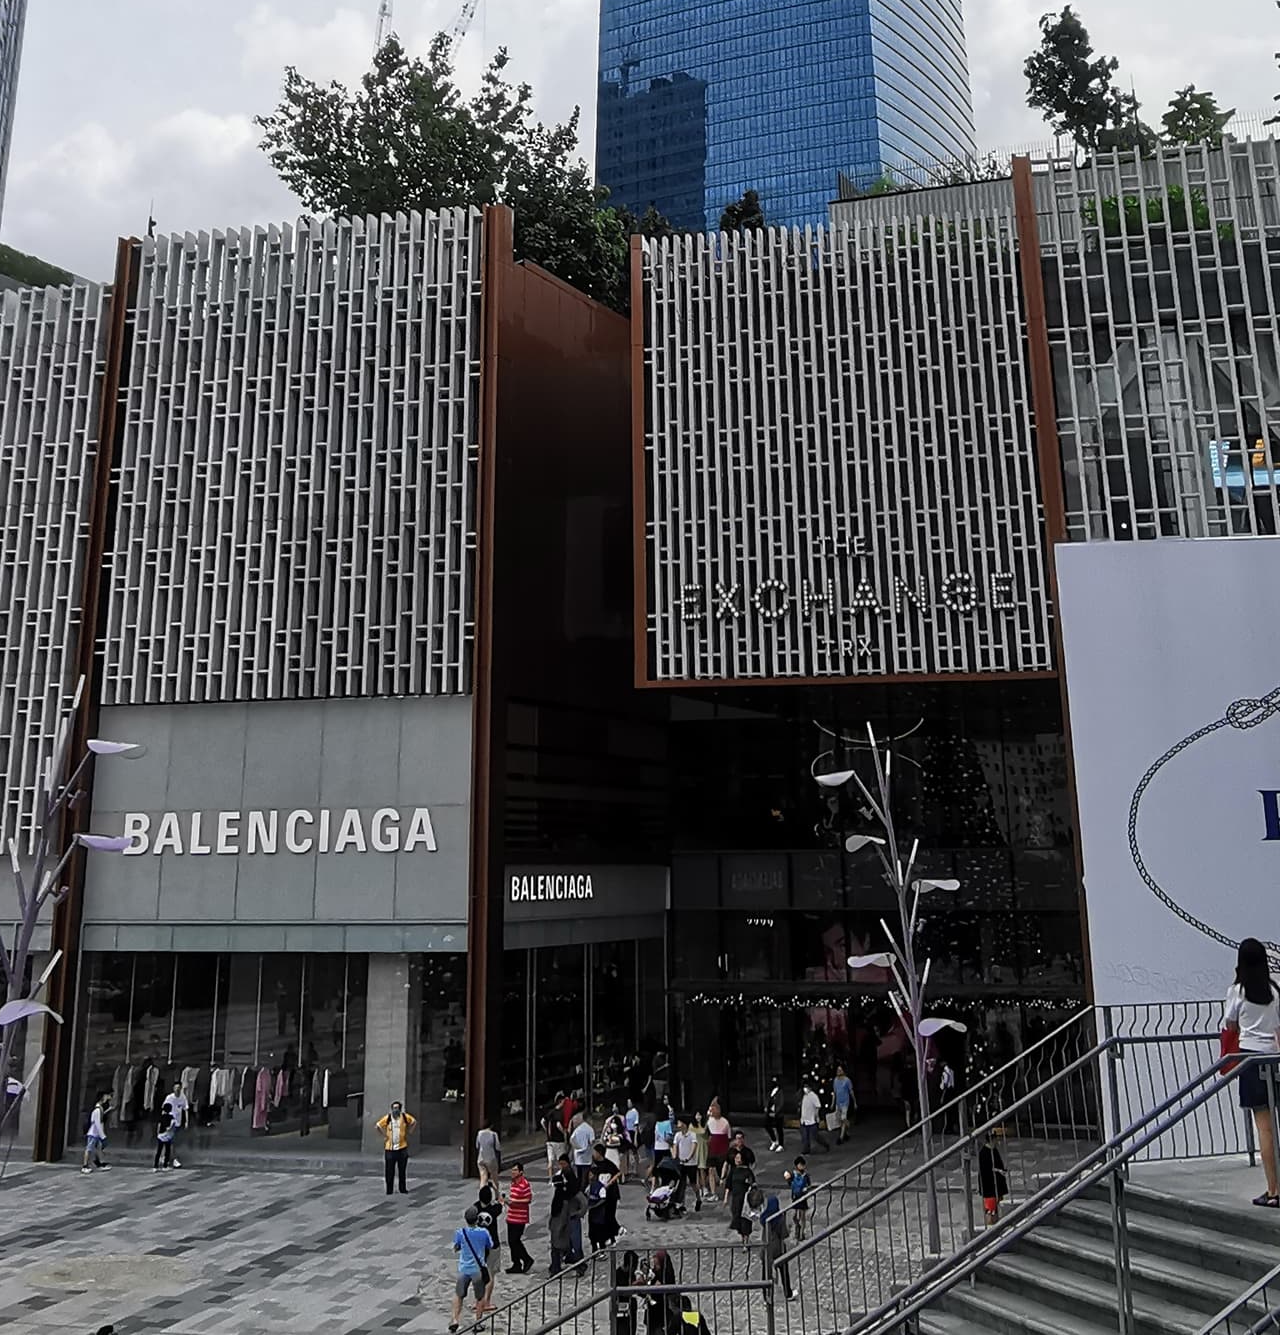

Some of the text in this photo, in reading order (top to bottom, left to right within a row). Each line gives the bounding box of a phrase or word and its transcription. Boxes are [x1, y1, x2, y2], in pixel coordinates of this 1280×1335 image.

[818, 536, 867, 556] THE
[679, 571, 1016, 621] EXCHANGE
[821, 638, 872, 657] TRX
[122, 807, 437, 856] BALENCIAGA
[511, 875, 593, 901] BALENCIAGA
